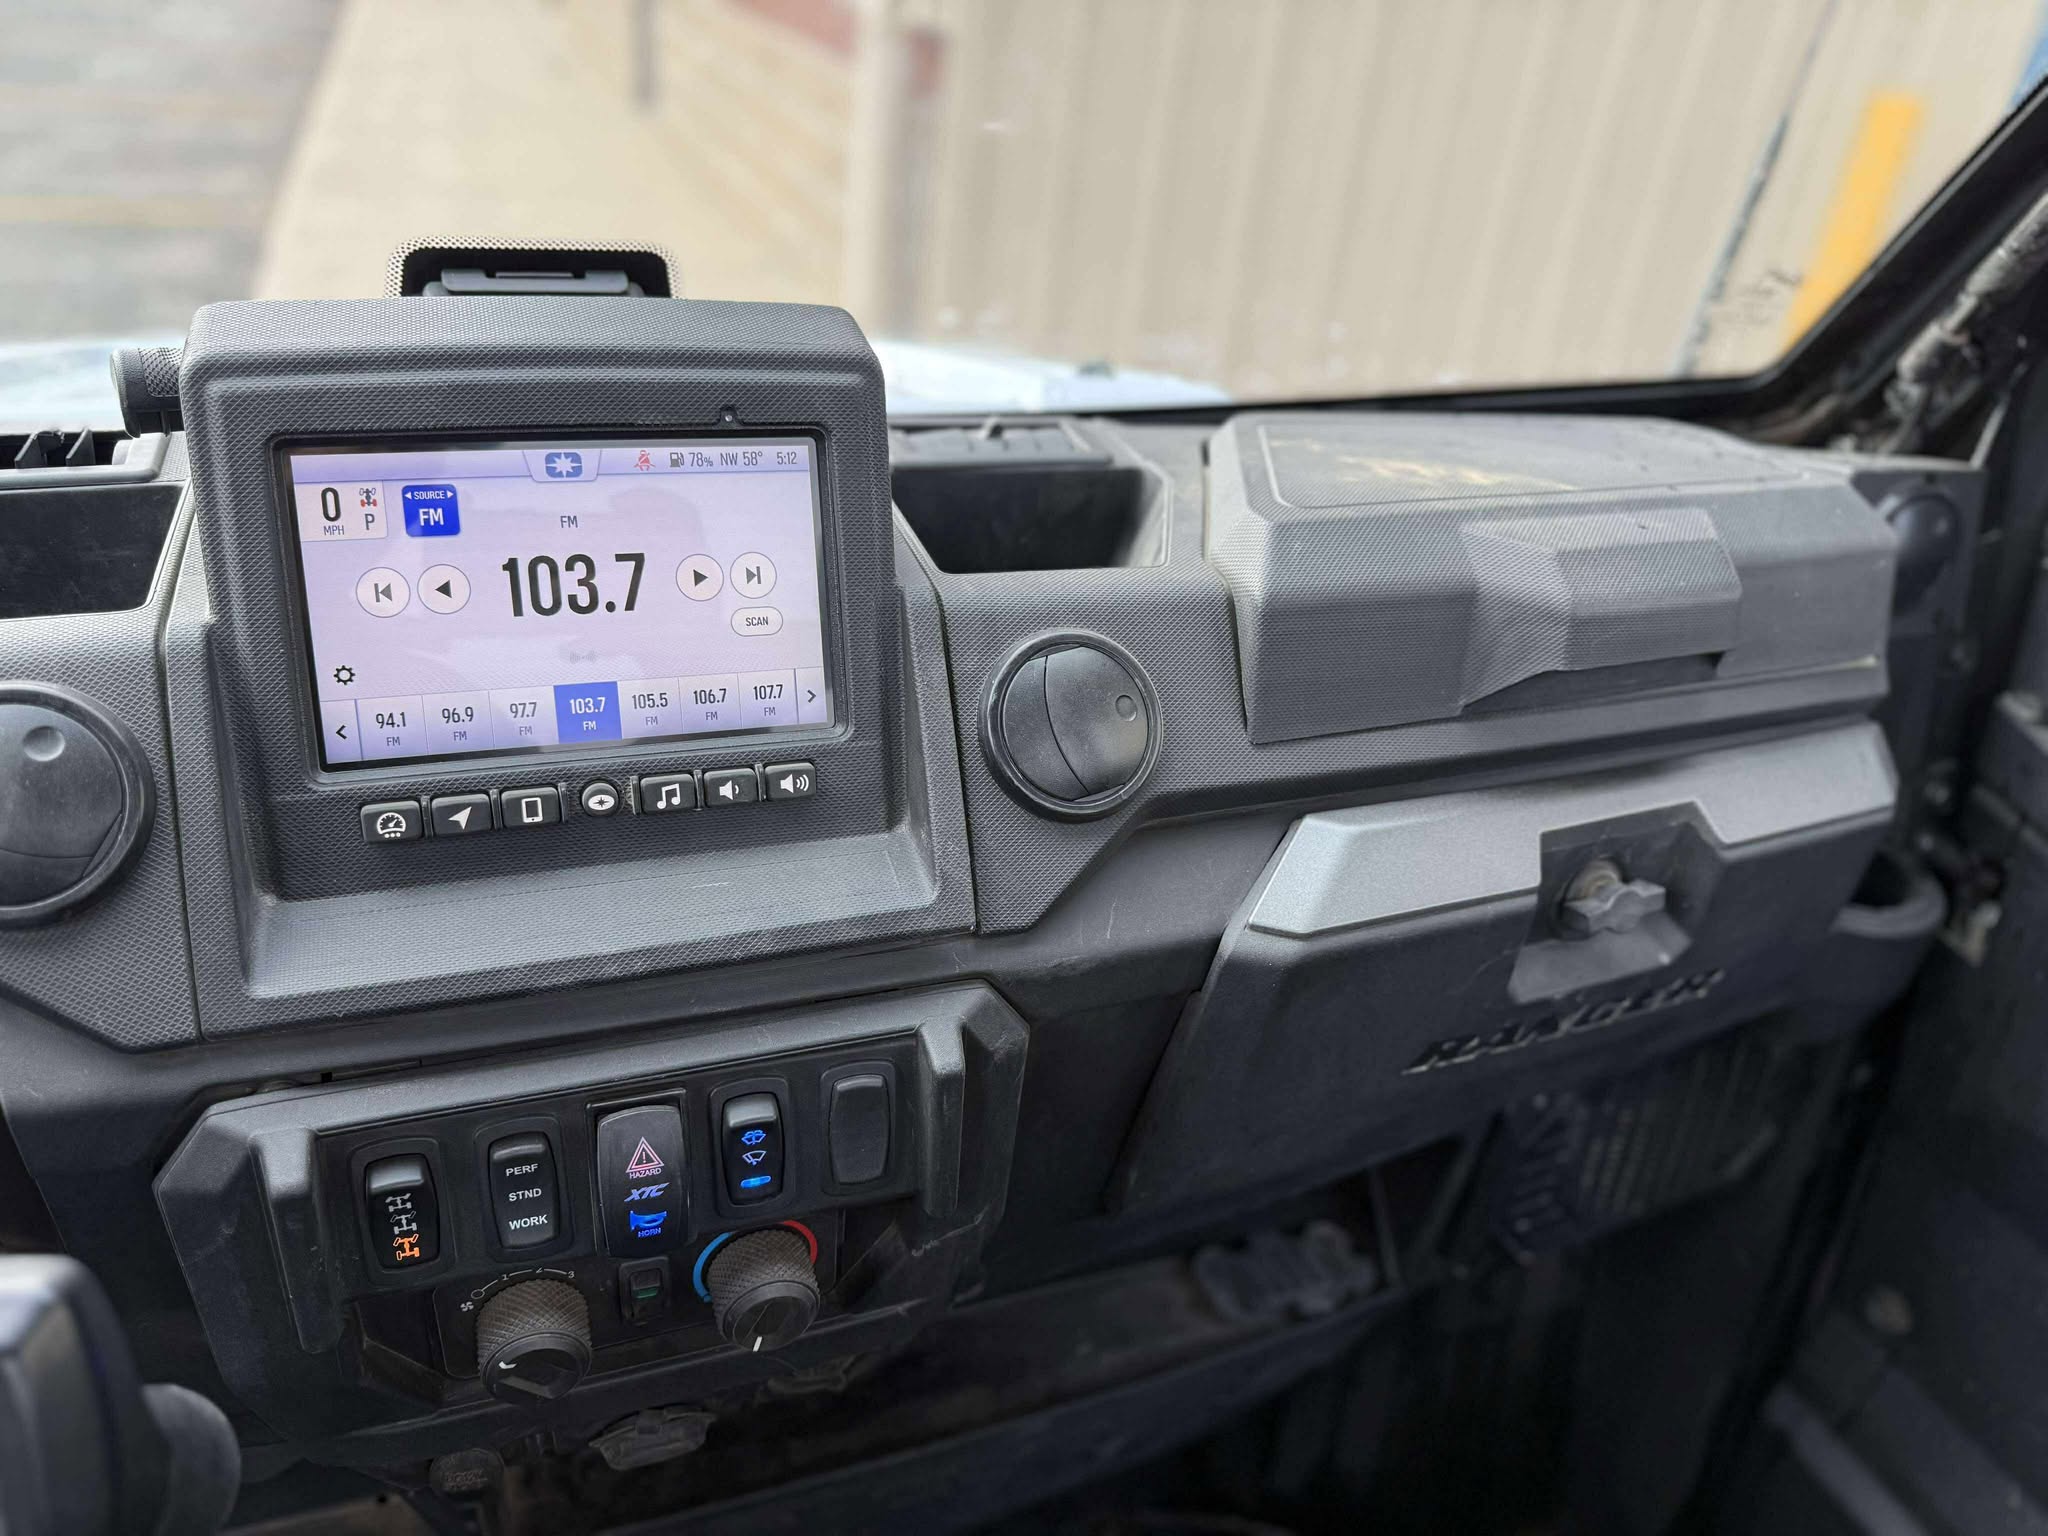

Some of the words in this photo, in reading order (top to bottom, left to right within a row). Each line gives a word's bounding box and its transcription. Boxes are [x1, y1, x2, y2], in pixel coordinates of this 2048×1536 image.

[689, 453, 714, 467] 78%
[720, 452, 739, 466] NW
[743, 451, 763, 466] 58°
[776, 452, 798, 466] 5:12
[413, 490, 445, 501] SOURCE
[320, 487, 342, 522] 0
[364, 513, 375, 530] P
[418, 508, 444, 526] FM
[560, 515, 578, 528] FM
[323, 525, 345, 536] MPH
[501, 552, 646, 618] 103.7
[745, 616, 769, 627] SCAN
[375, 711, 407, 729] 94.1
[441, 706, 474, 724] 96.9
[509, 702, 537, 719] 97.7
[569, 696, 606, 715] 103.7
[631, 692, 668, 710] 105.5
[693, 688, 727, 705] 106.7
[753, 684, 783, 701] 107.7
[386, 736, 401, 747] FM
[453, 731, 467, 741] FM
[519, 726, 533, 736] FM
[583, 720, 597, 731] FM
[645, 715, 659, 726] FM
[705, 711, 718, 721] FM
[763, 706, 776, 717] FM
[505, 1163, 539, 1177] PERF
[629, 1167, 662, 1179] HAZARD
[508, 1187, 542, 1202] STND
[624, 1182, 670, 1202] XTC
[508, 1214, 548, 1231] WORK
[637, 1227, 662, 1238] HORN
